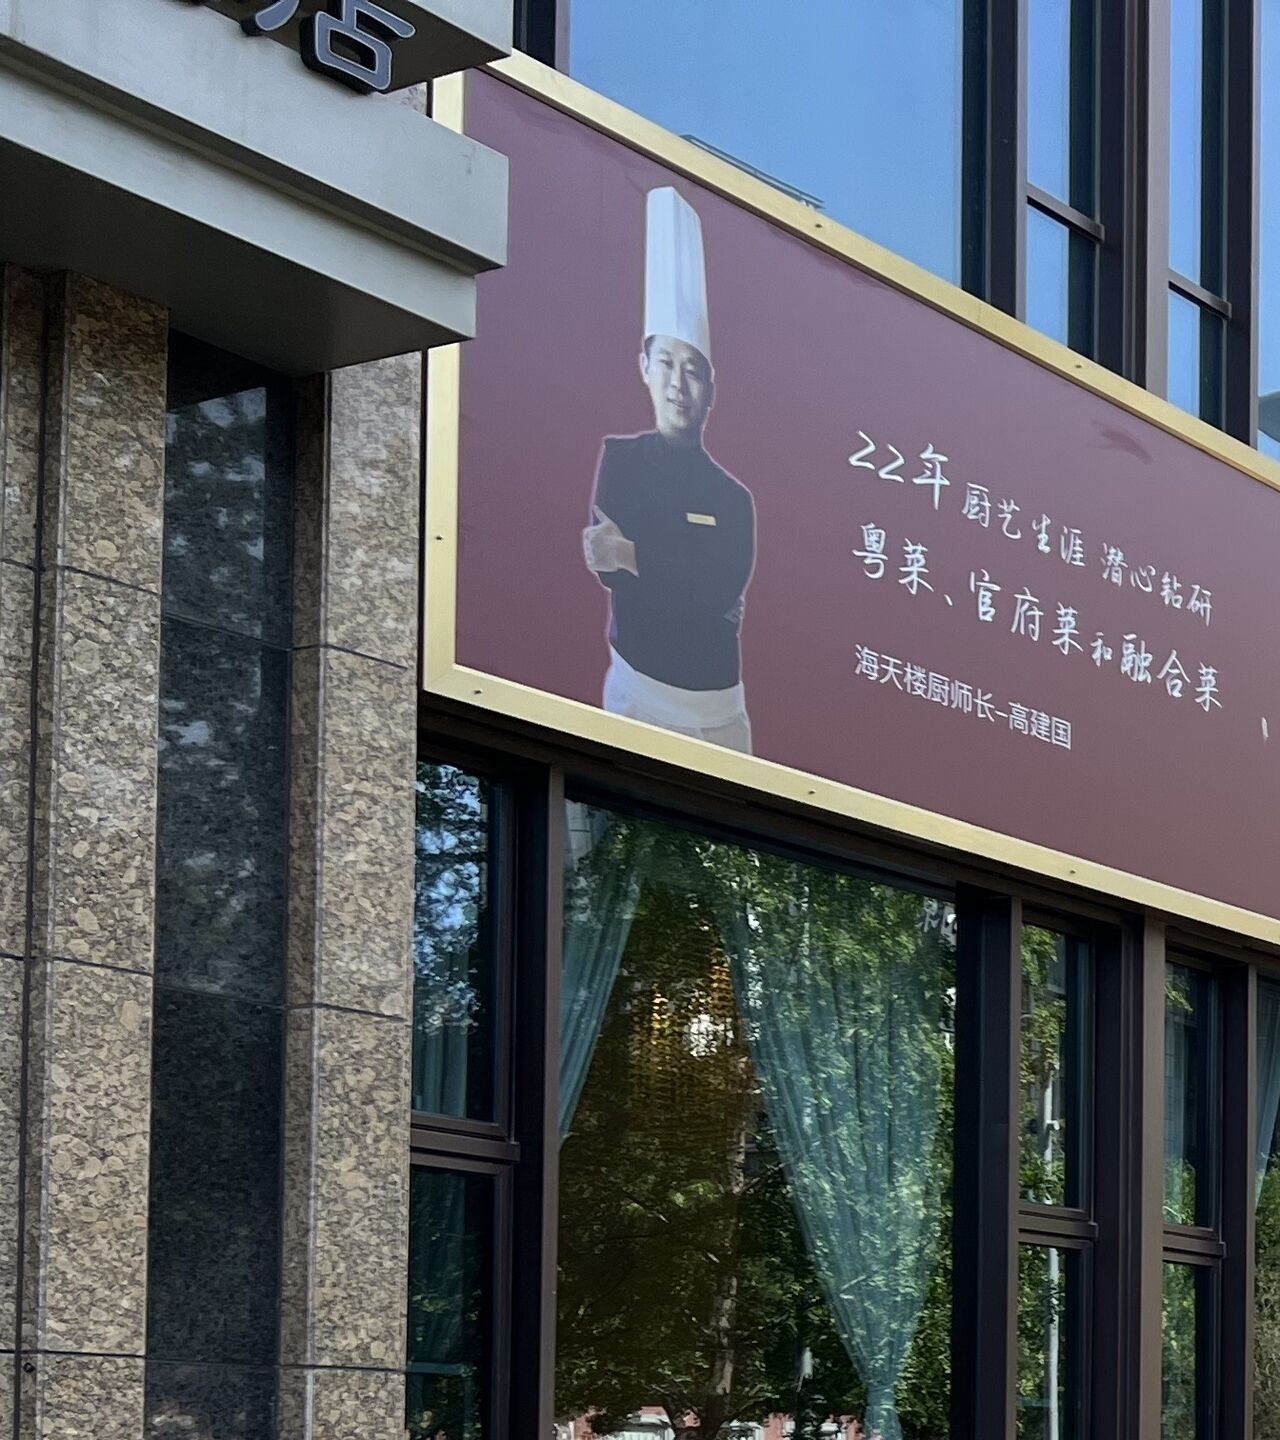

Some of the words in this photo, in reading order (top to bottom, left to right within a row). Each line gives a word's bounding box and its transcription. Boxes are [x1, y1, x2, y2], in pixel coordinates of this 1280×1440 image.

[848, 430, 950, 510] 22年
[962, 482, 1086, 567] 厨艺生涯
[1101, 543, 1213, 627] 潜心钻研
[852, 522, 1223, 712] 粤菜、官府菜和融合菜
